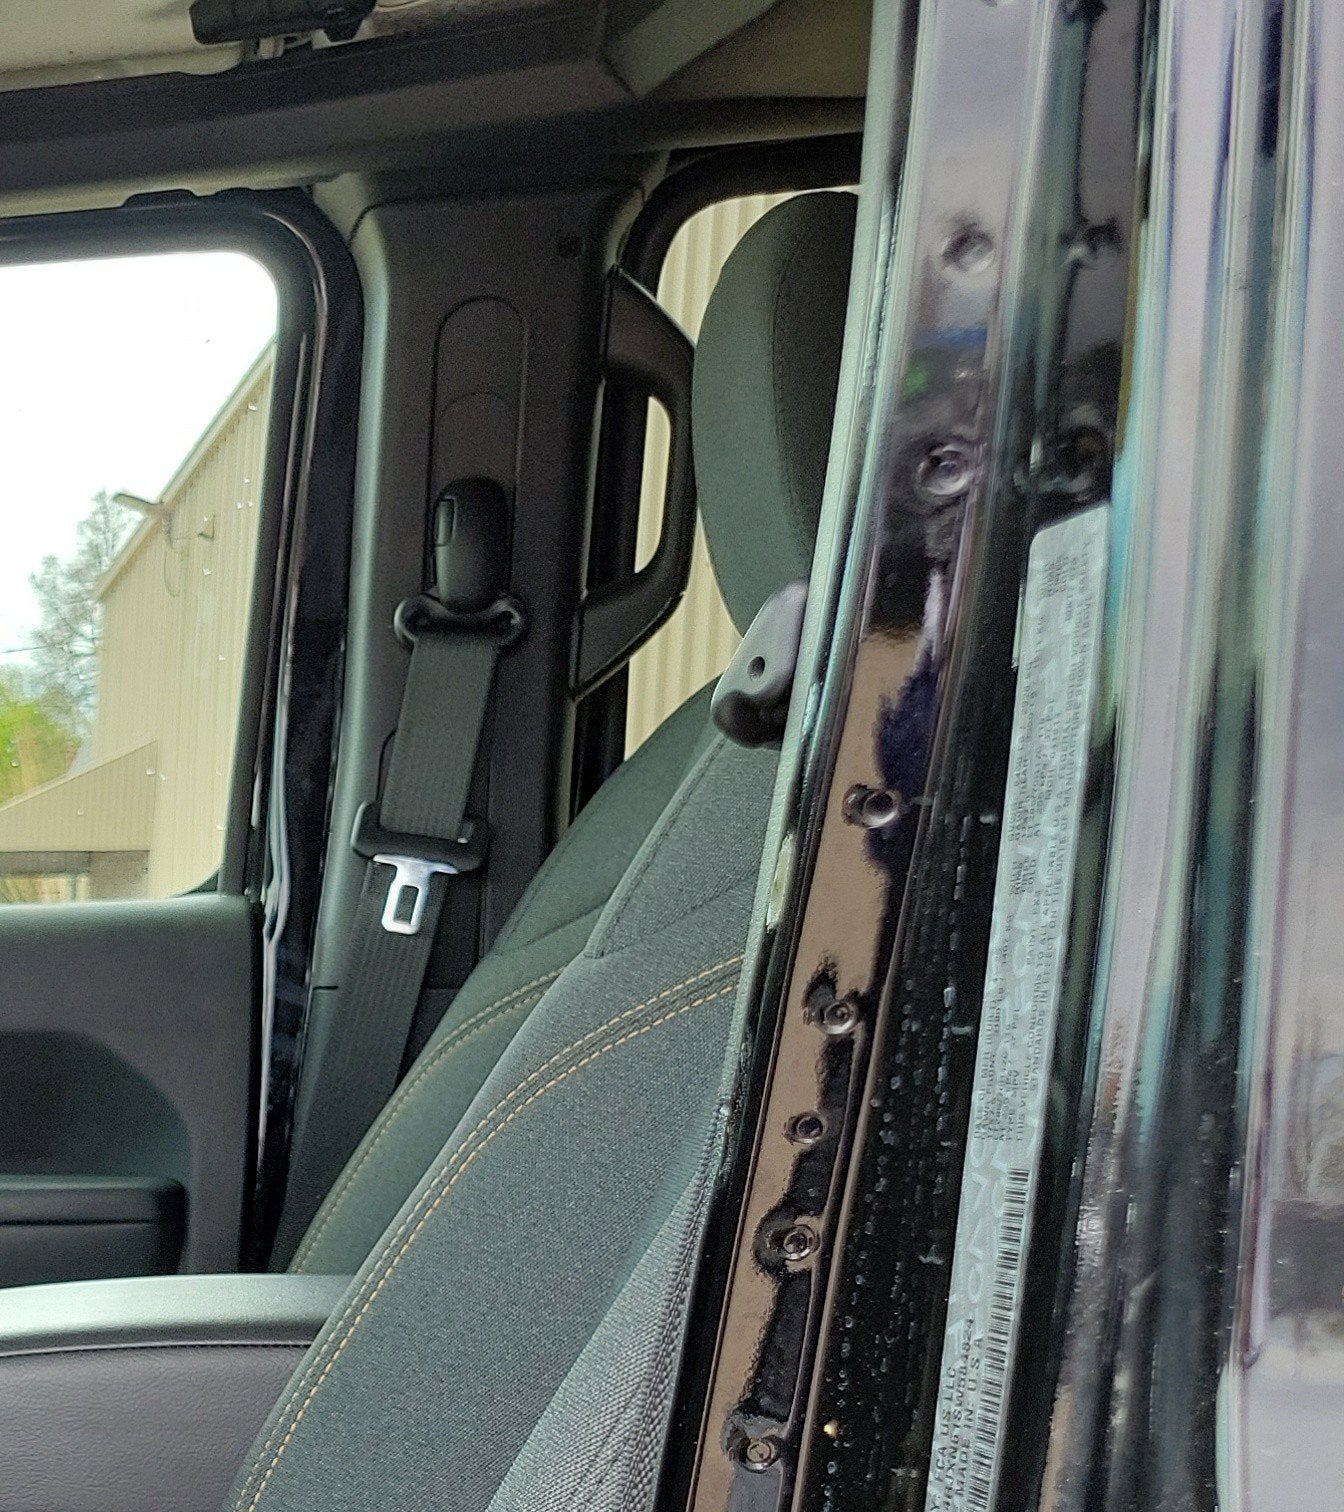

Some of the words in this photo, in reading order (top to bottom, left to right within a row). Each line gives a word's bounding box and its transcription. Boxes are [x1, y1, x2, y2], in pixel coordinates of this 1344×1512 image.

[942, 1364, 957, 1402] LLC
[938, 1407, 951, 1437] US
[933, 1443, 947, 1483] FCA
[953, 1436, 971, 1498] MADE
